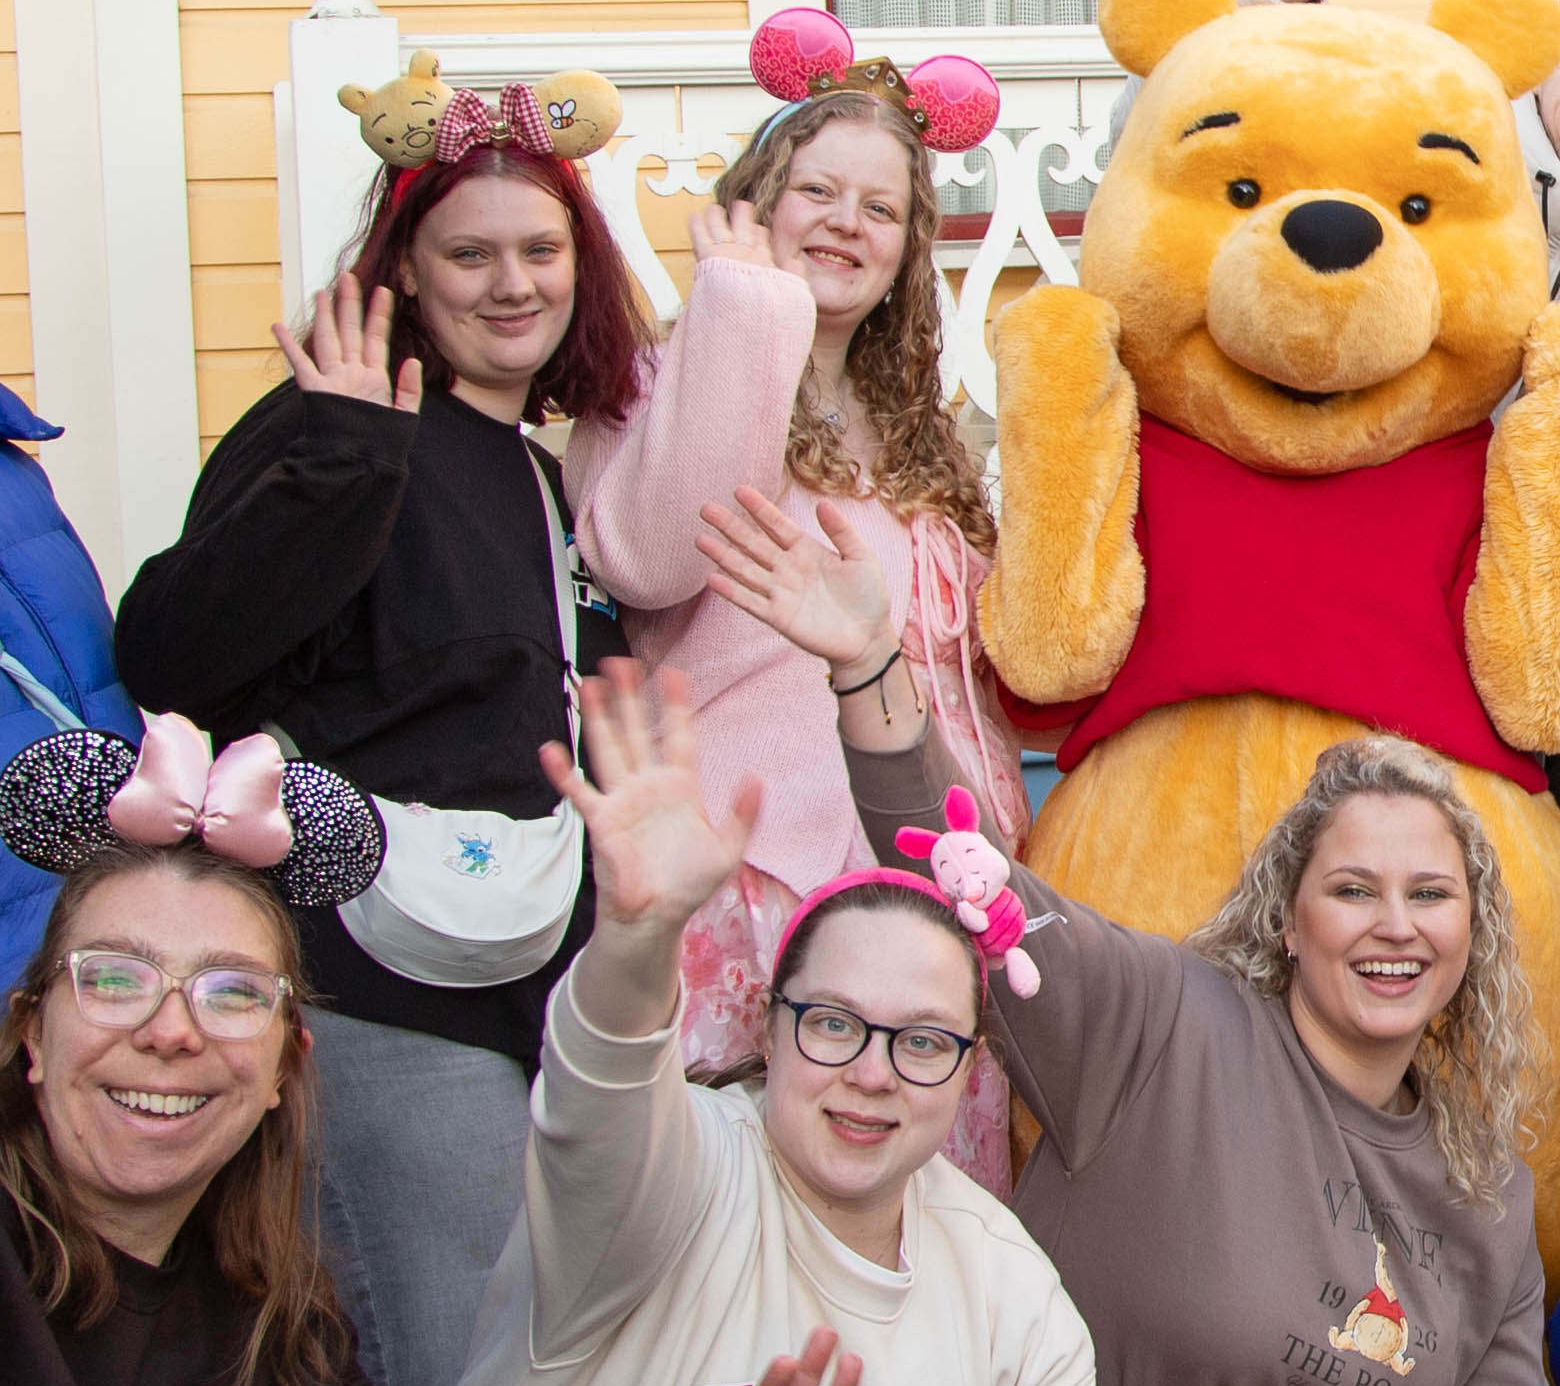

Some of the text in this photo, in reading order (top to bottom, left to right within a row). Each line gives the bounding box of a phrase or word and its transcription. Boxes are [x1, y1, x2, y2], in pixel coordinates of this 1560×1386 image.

[1317, 1279, 1347, 1310] 19
[1413, 1325, 1439, 1354] 26
[1280, 1333, 1346, 1386] THE
